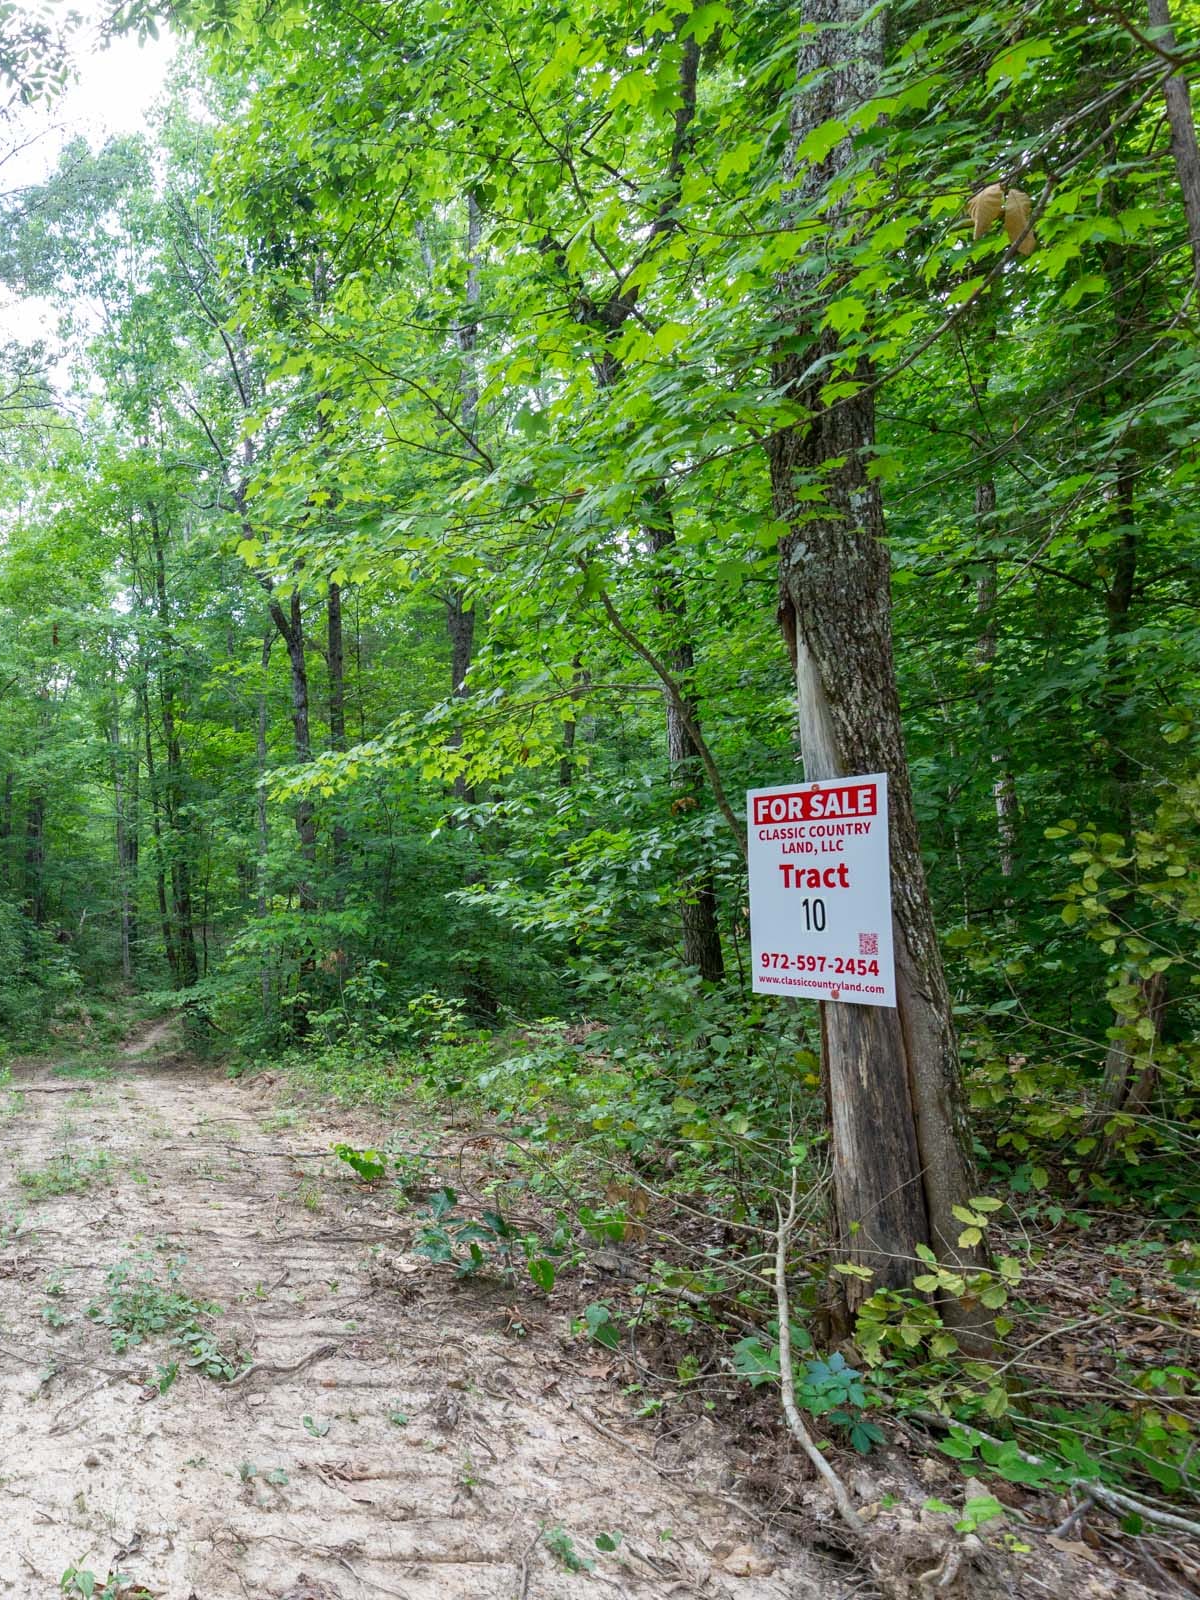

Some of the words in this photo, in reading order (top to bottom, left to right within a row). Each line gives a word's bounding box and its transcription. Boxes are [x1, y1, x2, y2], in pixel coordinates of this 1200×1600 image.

[757, 796, 803, 822] FOR
[809, 789, 873, 818] SALE
[759, 826, 806, 841] CLASSIC
[810, 822, 872, 838] COUNTRY
[782, 841, 818, 856] LAND,
[821, 839, 844, 852] LLC
[779, 863, 850, 889] Tract
[802, 898, 827, 932] 10
[761, 952, 880, 977] 972-597-2454
[759, 974, 885, 994] www.classiccountryland.com
